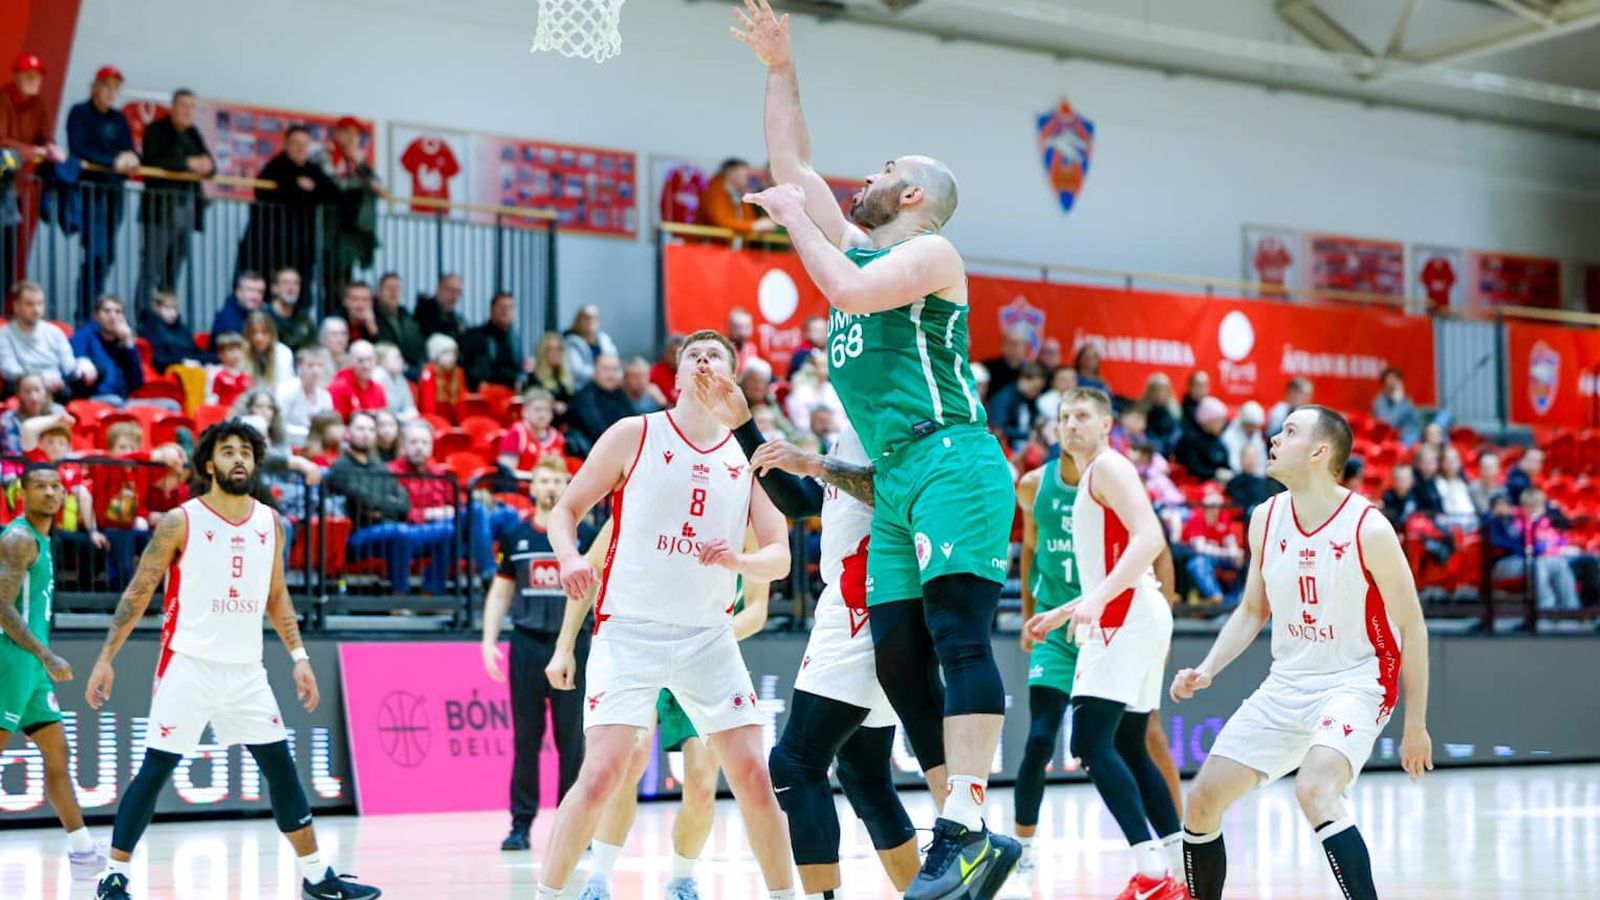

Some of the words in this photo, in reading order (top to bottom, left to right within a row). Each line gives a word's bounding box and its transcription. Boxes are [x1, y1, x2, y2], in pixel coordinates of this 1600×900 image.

[831, 323, 863, 368] 68
[690, 488, 706, 516] 8
[232, 556, 243, 578] 9
[1299, 576, 1318, 604] 10
[446, 689, 510, 731] BÓN
[450, 738, 508, 757] DEIL
